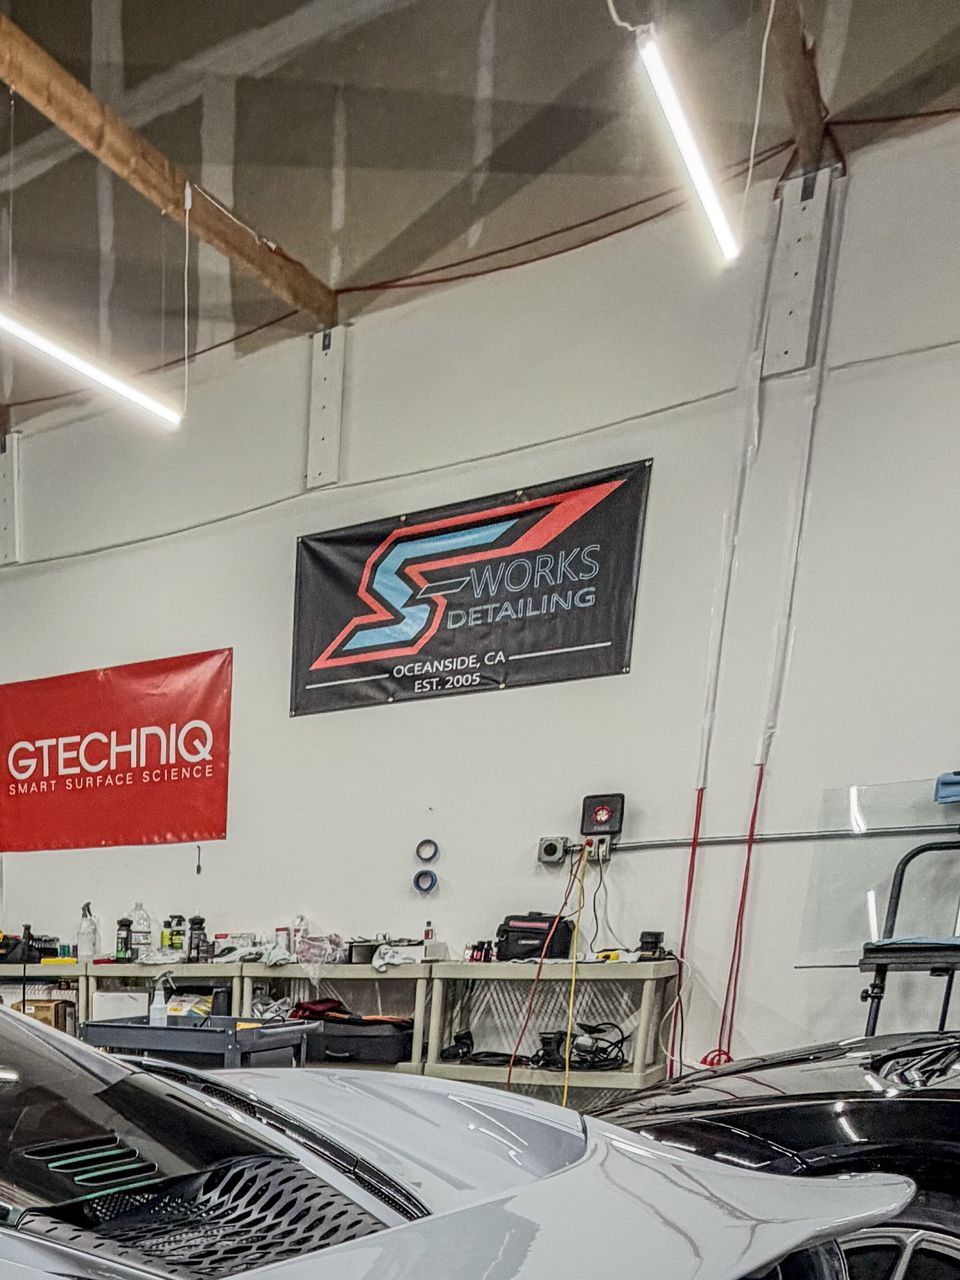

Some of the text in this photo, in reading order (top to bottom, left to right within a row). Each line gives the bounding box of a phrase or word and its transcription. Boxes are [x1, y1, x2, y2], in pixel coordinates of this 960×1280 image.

[446, 586, 597, 630] DETAILING
[392, 650, 506, 679] OCEANSIDE, CA
[414, 672, 481, 693] EST. 2005
[8, 764, 214, 796] SMART SURFACE SCIENCE
